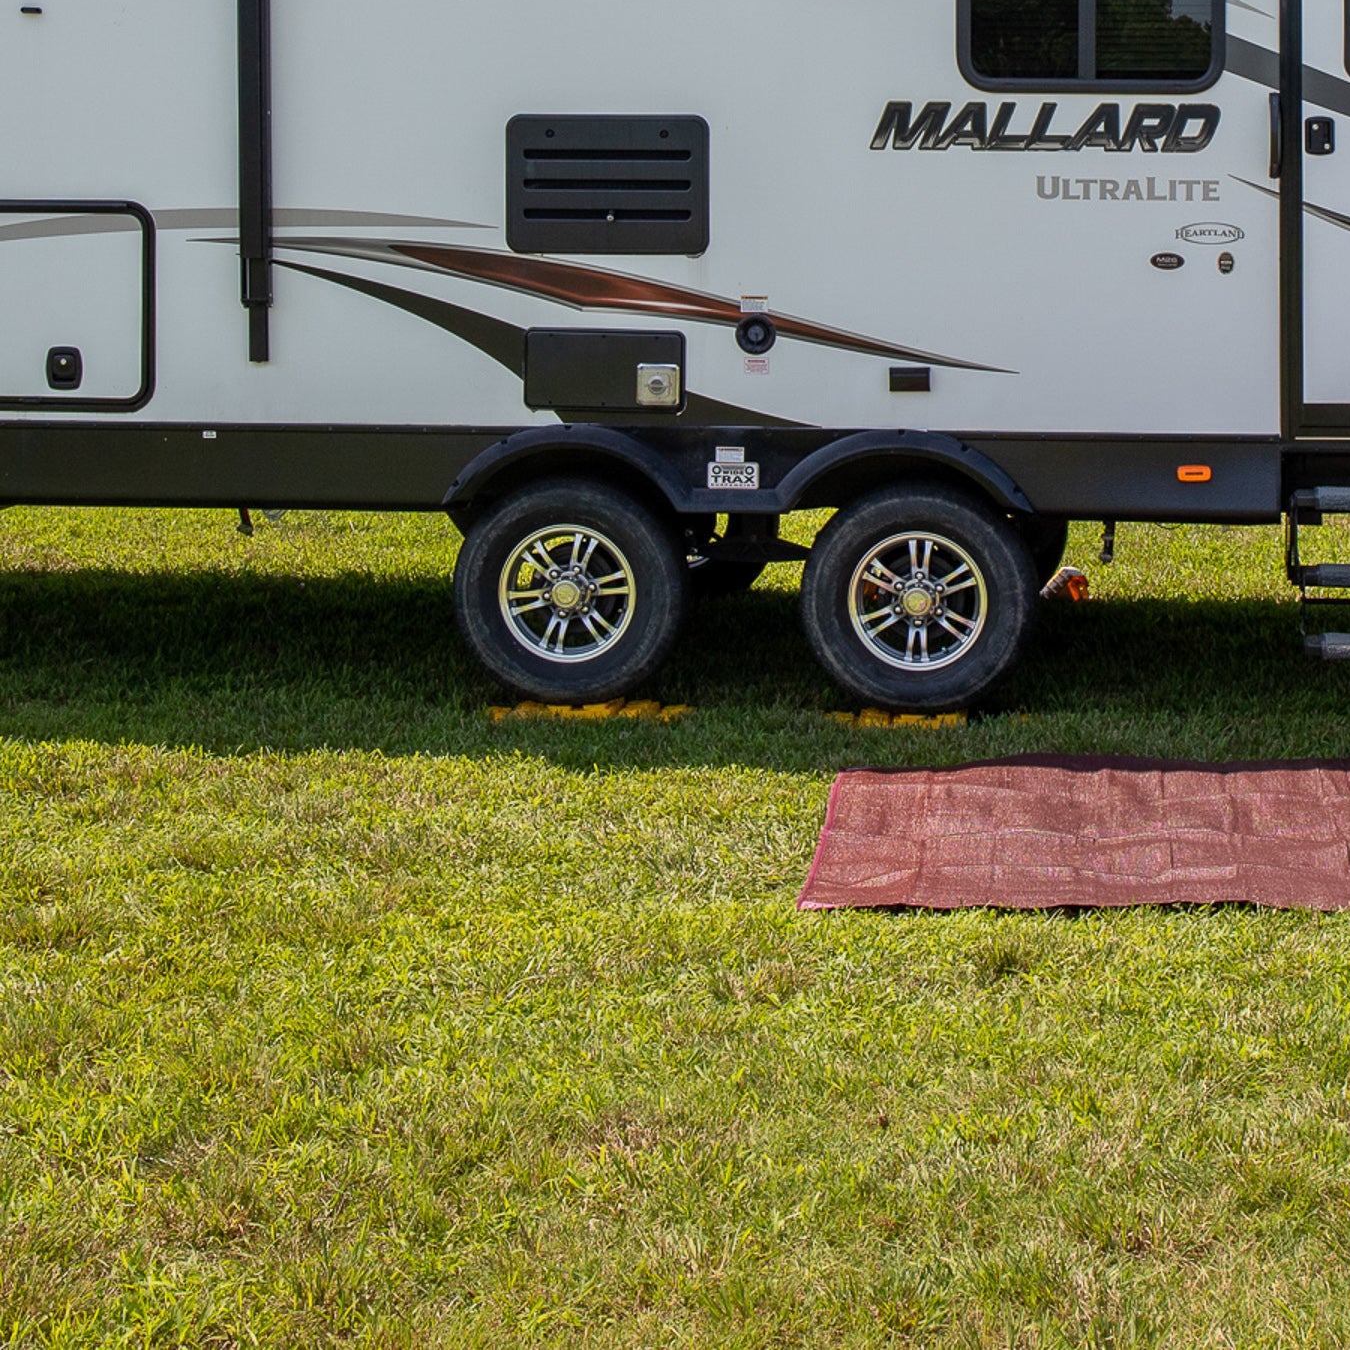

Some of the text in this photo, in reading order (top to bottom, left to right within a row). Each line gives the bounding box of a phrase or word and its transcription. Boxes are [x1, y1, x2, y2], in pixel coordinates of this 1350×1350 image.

[869, 101, 1222, 152] MALLARD
[1174, 228, 1245, 239] HEARTLAND
[710, 475, 756, 483] TRAX
